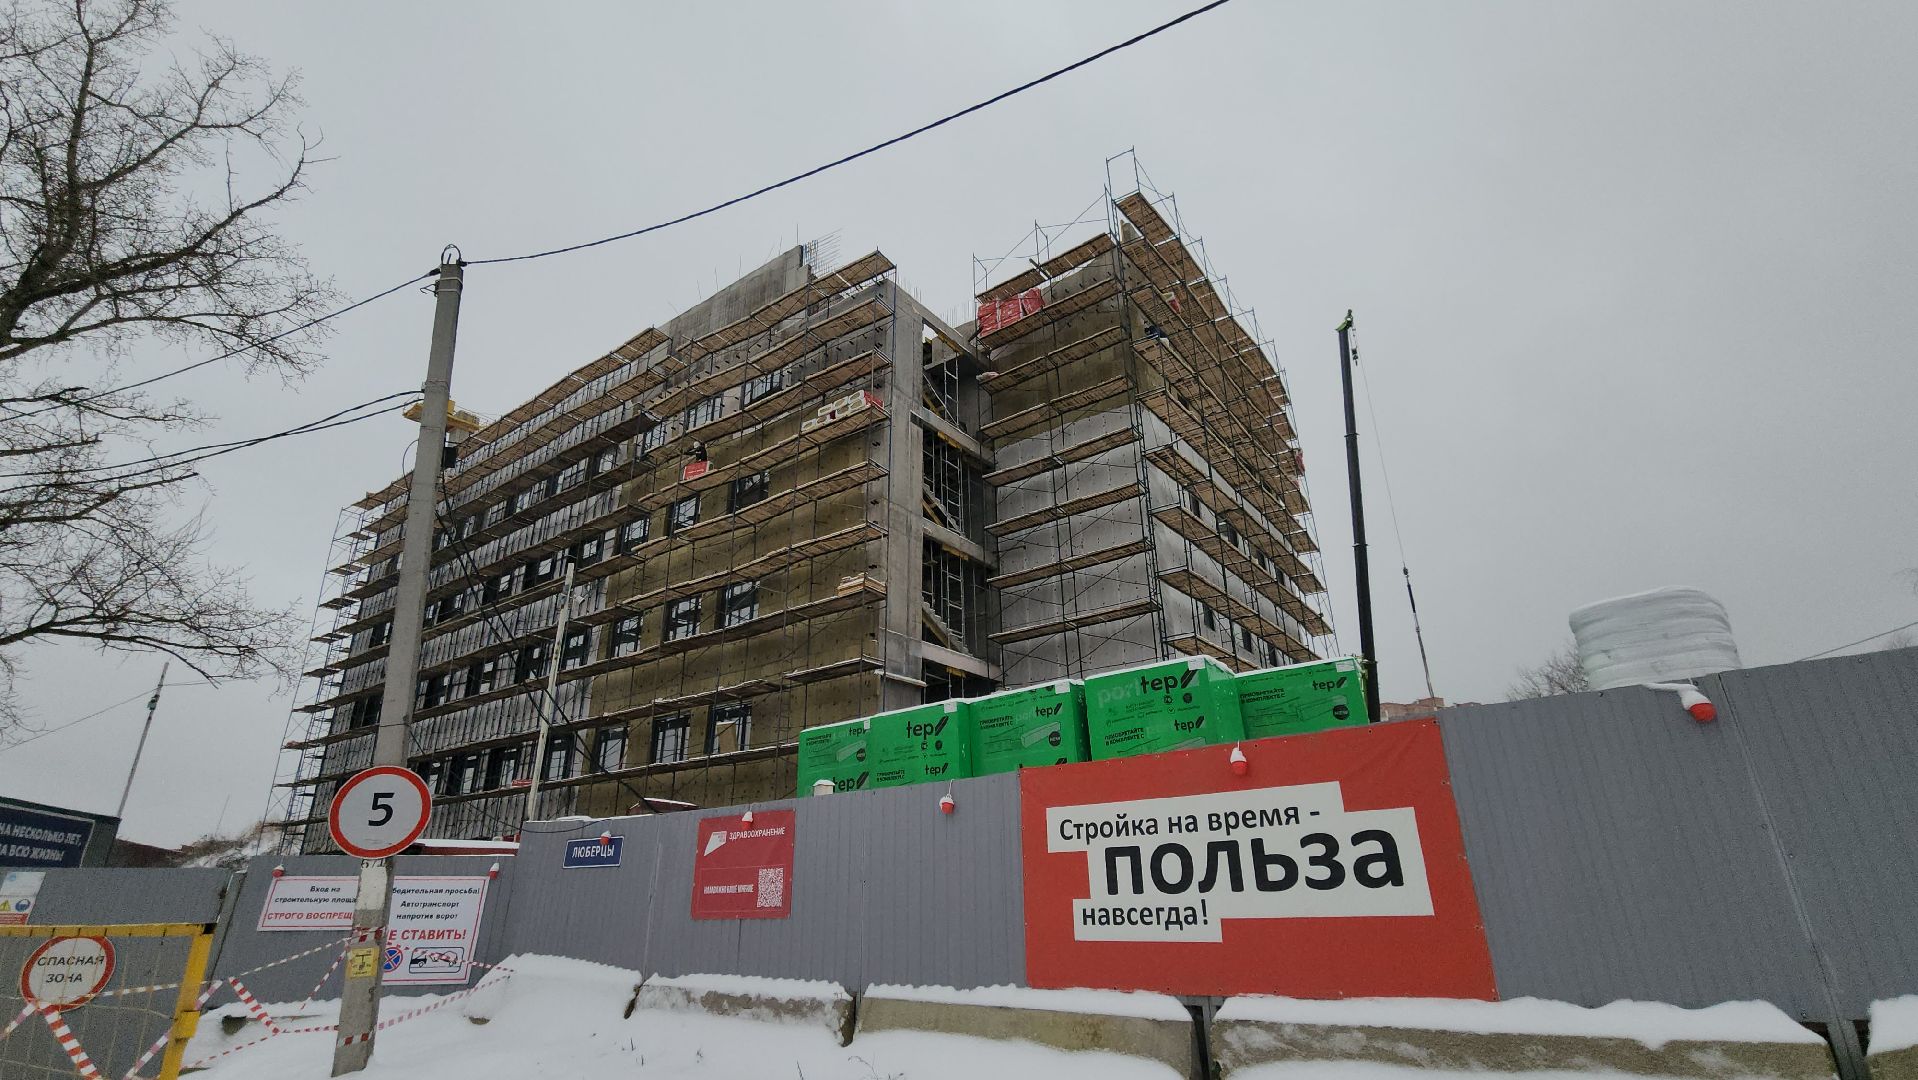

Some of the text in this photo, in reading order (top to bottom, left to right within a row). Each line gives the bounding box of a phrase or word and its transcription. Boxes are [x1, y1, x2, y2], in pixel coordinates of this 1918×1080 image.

[367, 792, 395, 827] 5
[1058, 813, 1160, 845] Стройка
[1167, 813, 1199, 835] на
[1207, 805, 1301, 838] время
[12, 825, 64, 843] НЕСКОЛЬКО
[728, 827, 786, 841] ЗДРАВООХРАНЕНИЕ
[9, 845, 30, 858] ВСЮ
[571, 844, 615, 858] ЛЮБЕРЦЫ
[309, 885, 328, 893] Вход
[392, 887, 480, 895] бедительная просьба!
[400, 900, 460, 908] Автотранспорт
[267, 911, 353, 921] СТРОГО ВОСПРЕЩ
[396, 913, 458, 921] напротив ворот
[1081, 899, 1210, 931] навсегда!
[400, 929, 467, 940] СТАВИТЬ!
[46, 973, 83, 983] ЗОНА
